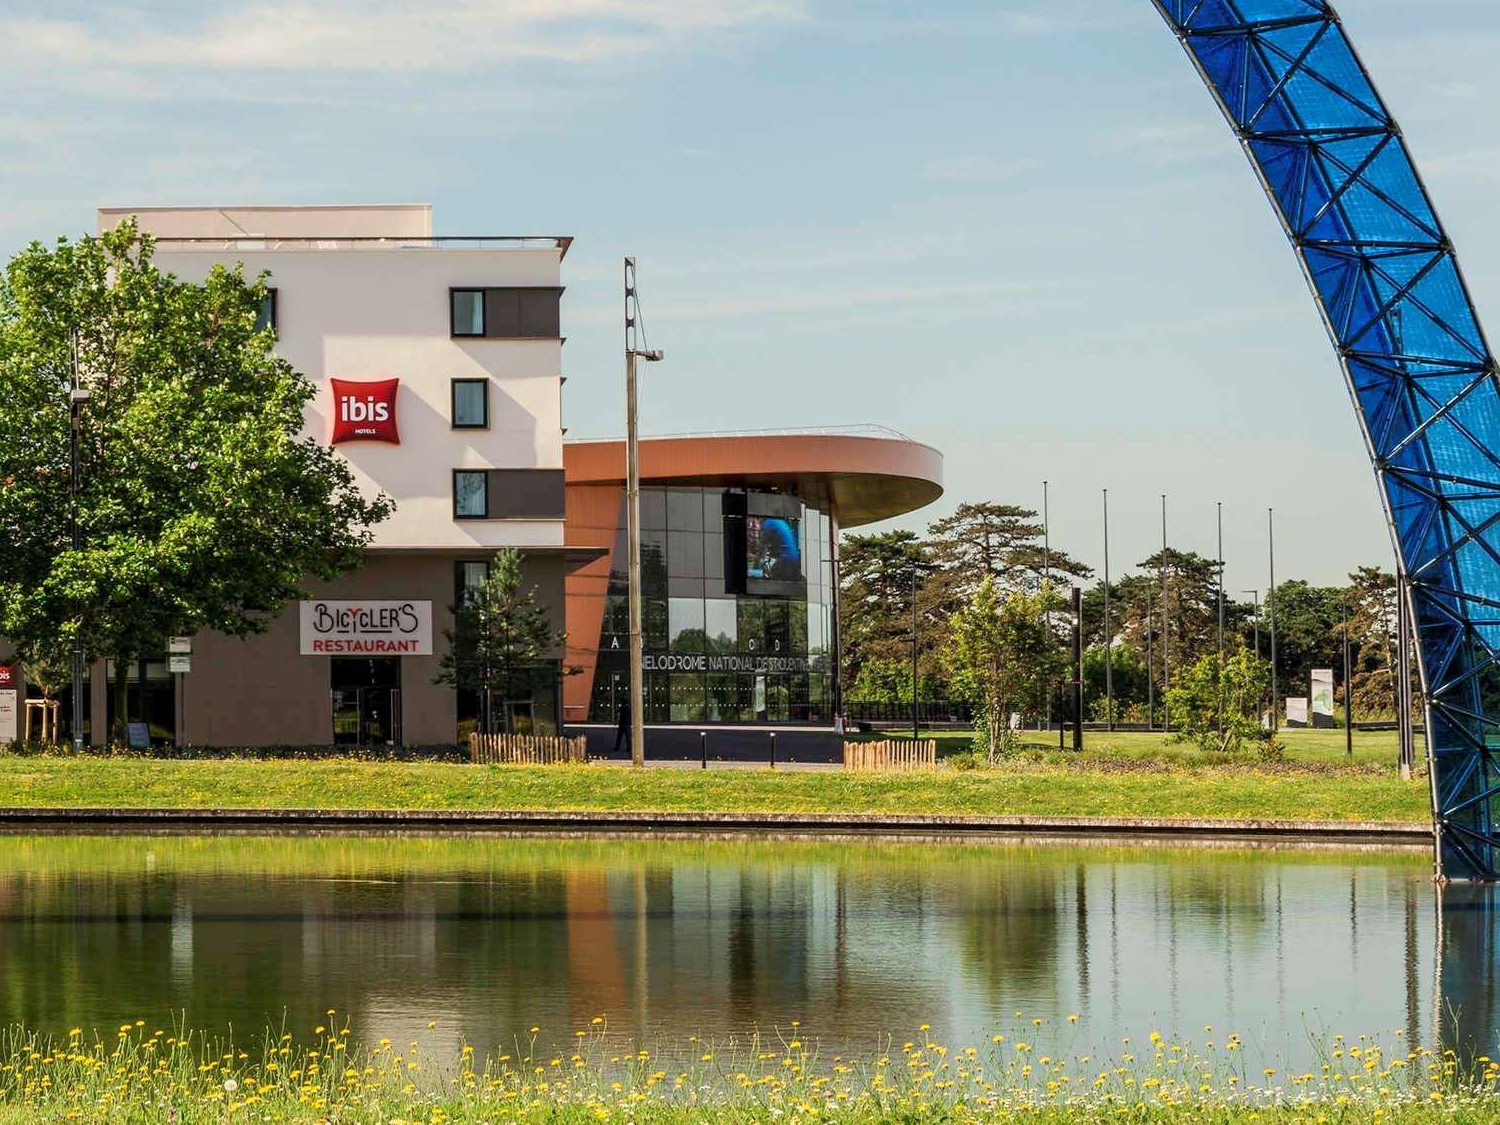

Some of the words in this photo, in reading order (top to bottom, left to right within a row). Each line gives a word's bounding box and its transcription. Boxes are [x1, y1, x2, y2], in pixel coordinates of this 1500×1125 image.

[341, 395, 389, 422] ibis
[313, 639, 420, 652] RESTAURANT
[611, 636, 620, 649] A
[642, 655, 707, 670] ELODROME
[708, 656, 754, 671] NATIONAL
